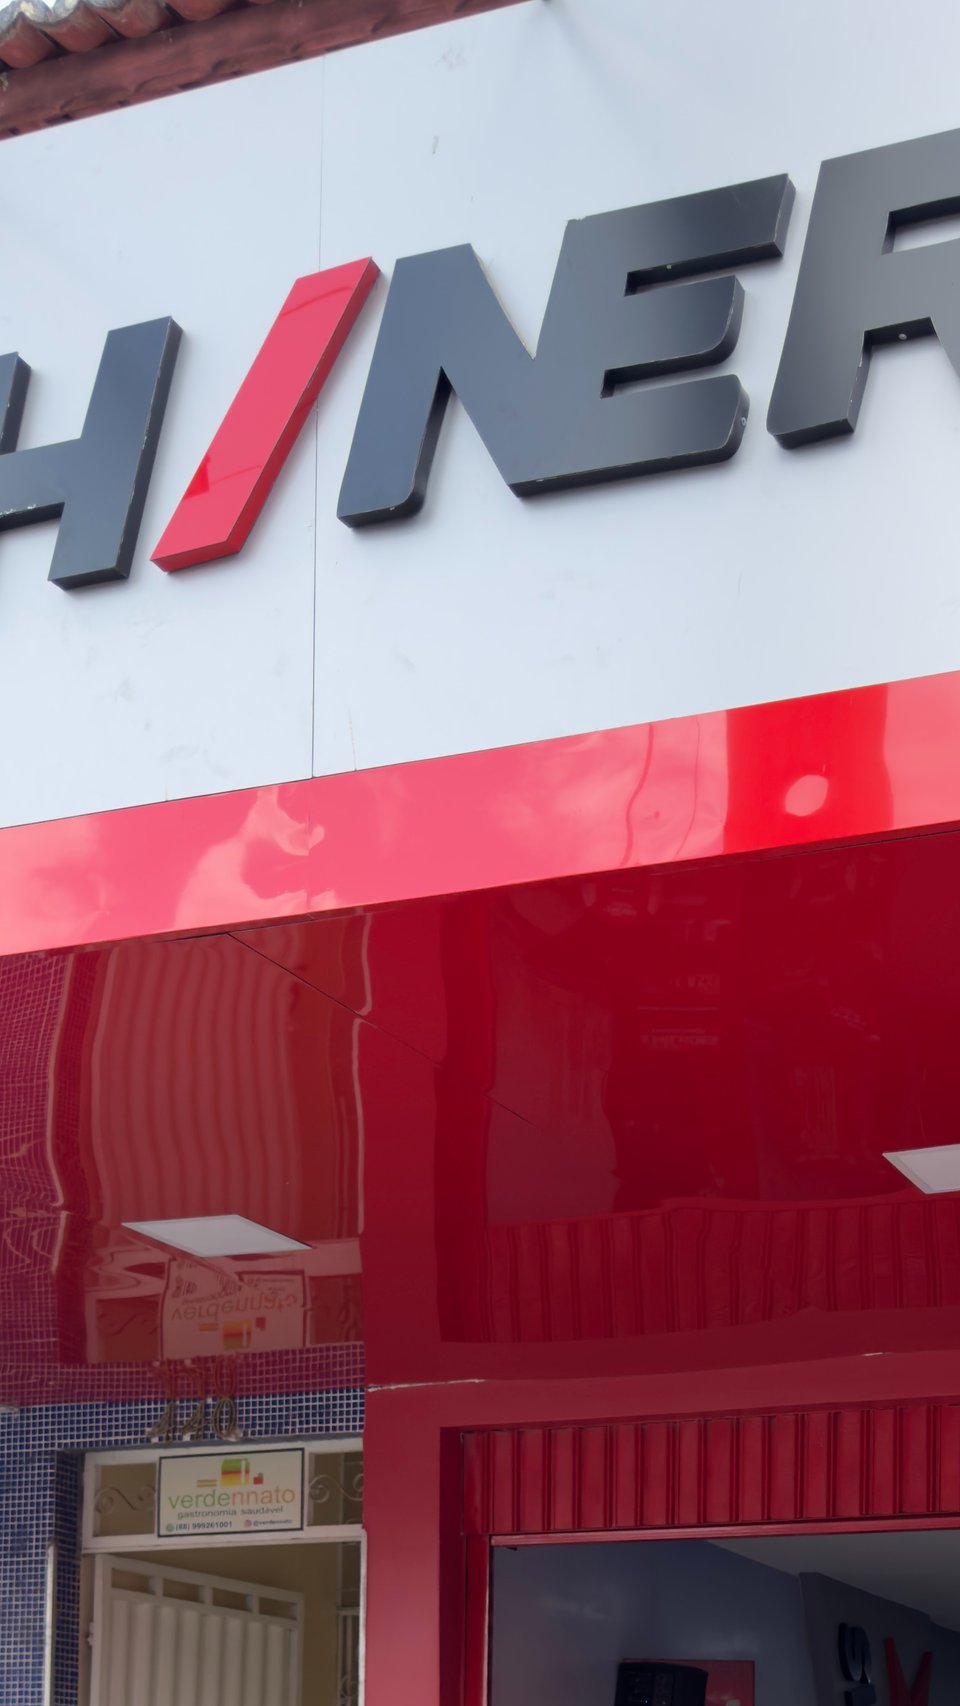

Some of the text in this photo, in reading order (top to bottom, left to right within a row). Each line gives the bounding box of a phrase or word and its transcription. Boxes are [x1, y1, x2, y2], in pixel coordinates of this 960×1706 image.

[168, 1486, 296, 1509] verdennato
[177, 1506, 283, 1520] gastronomia saudável
